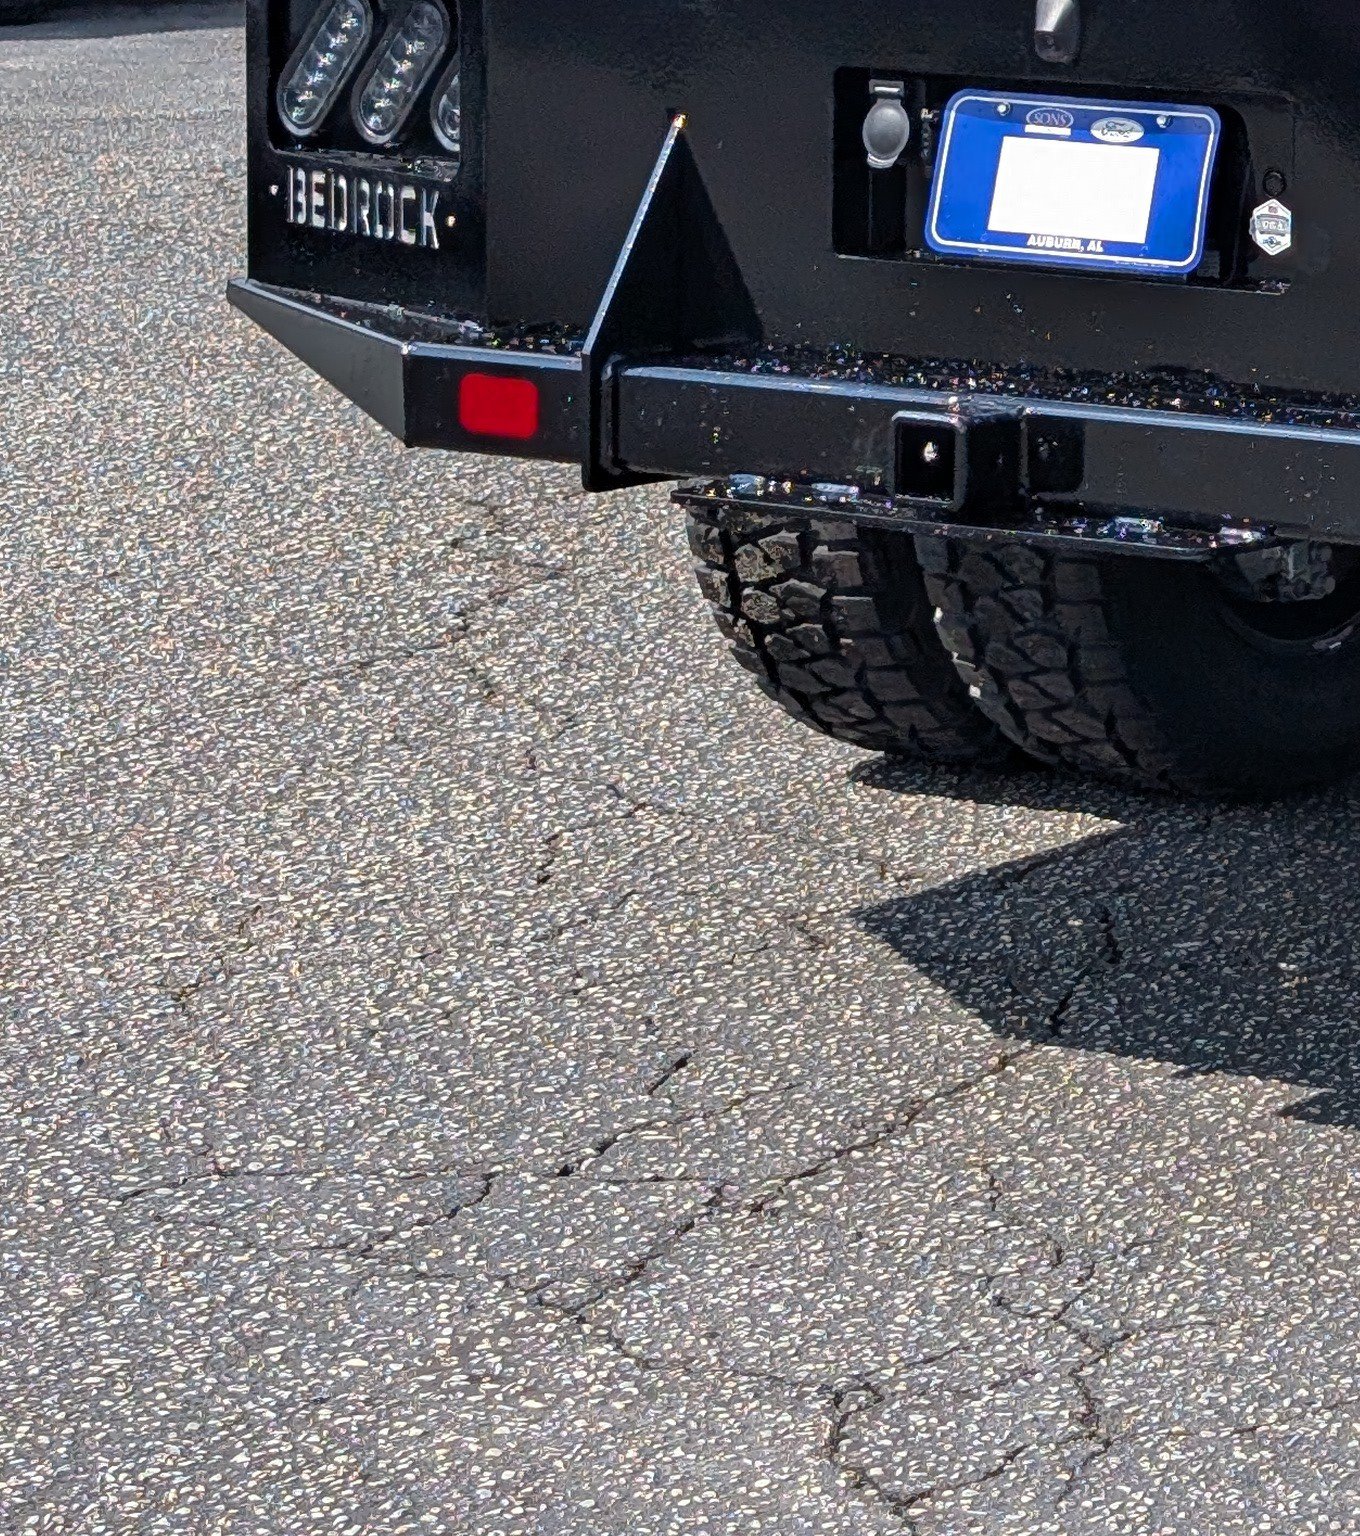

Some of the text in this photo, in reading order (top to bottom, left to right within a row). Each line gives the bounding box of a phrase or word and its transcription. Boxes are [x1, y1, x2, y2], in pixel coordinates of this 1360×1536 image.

[1033, 112, 1068, 127] SONS
[286, 164, 440, 250] BEDROCK
[1027, 234, 1104, 253] AUBURN, AL
